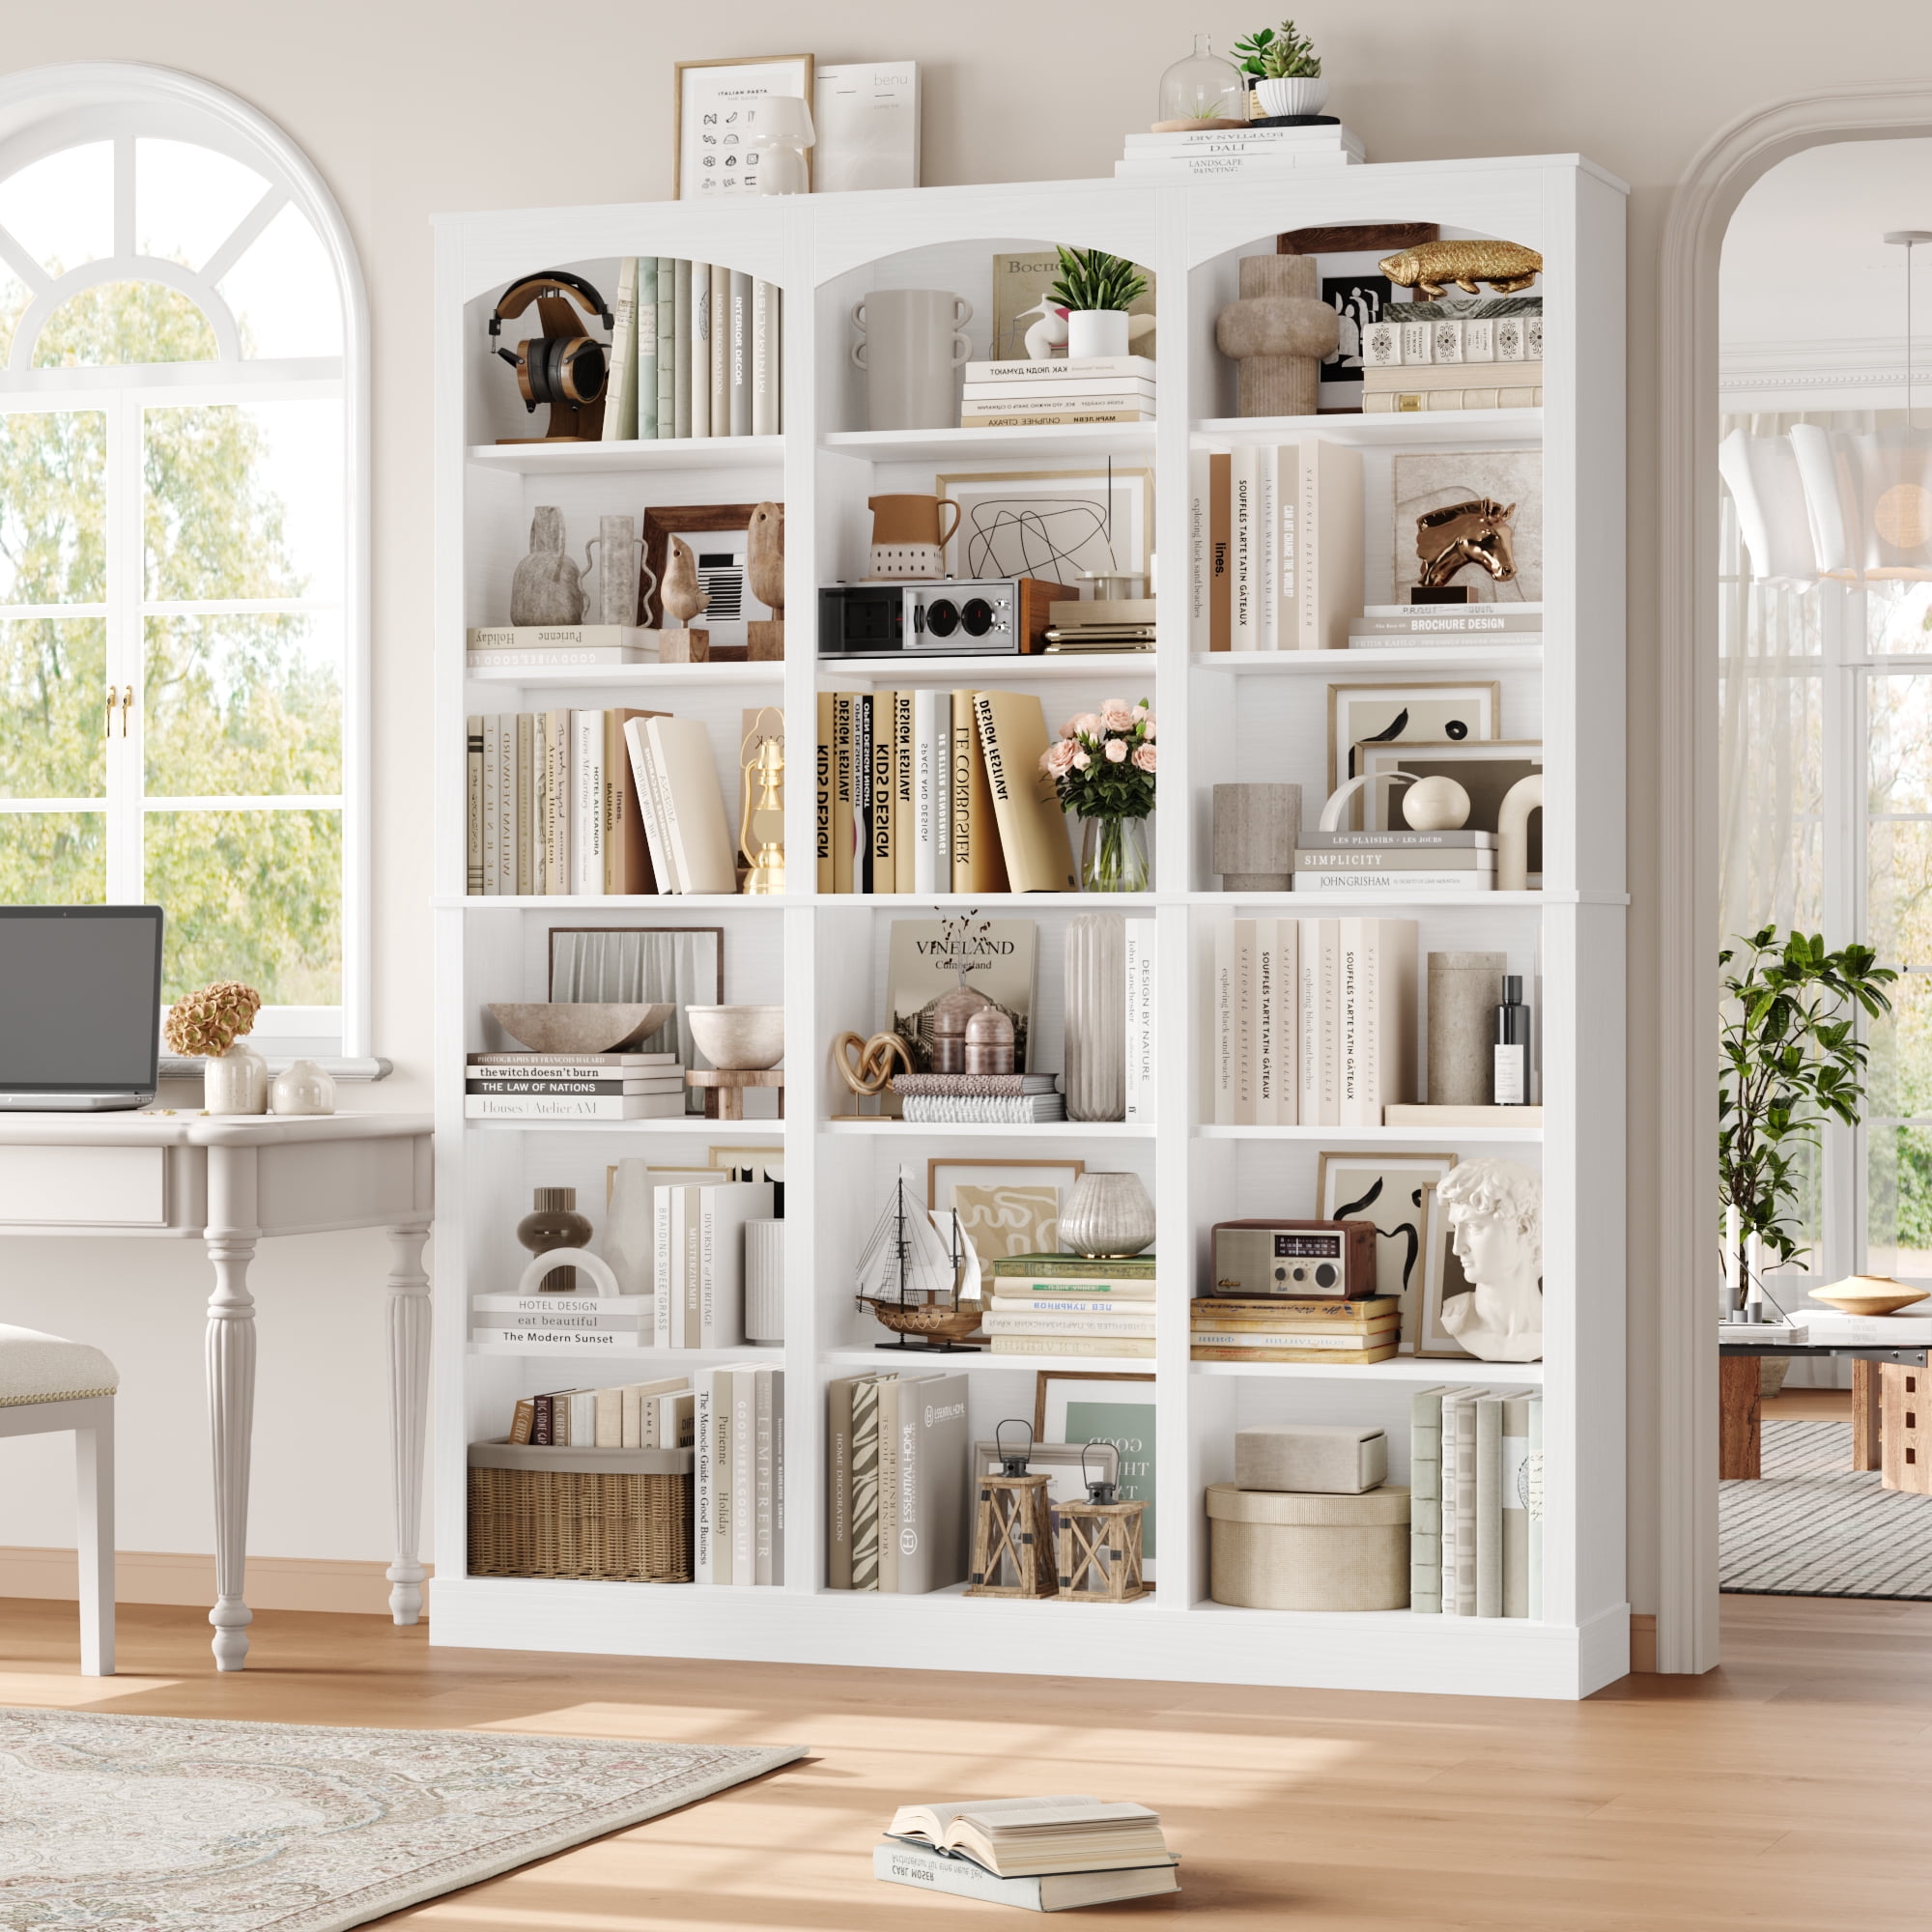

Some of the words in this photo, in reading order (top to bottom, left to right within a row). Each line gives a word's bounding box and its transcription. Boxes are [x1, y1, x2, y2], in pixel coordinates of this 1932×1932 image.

[874, 72, 908, 85] benu
[1189, 158, 1242, 168] LANDSCAPE
[1192, 497, 1203, 538] exploring
[1194, 540, 1203, 562] black
[1215, 542, 1226, 577] lines.
[1194, 564, 1203, 583] sand
[1194, 585, 1203, 618] beaches
[1411, 619, 1465, 631] BROCHURE
[1468, 618, 1505, 629] DESIGN
[476, 631, 514, 645] Holiday
[538, 632, 582, 642] Purienne
[1305, 855, 1382, 866] SIMPLICITY
[917, 941, 1014, 954] VINELAND
[1127, 939, 1136, 964] John
[1220, 968, 1230, 1008] exploring
[1304, 968, 1314, 1008] exploring
[1142, 1011, 1150, 1027] BY
[573, 1068, 599, 1077] burn
[482, 1083, 502, 1092] THE
[507, 1083, 528, 1092] LAW
[532, 1083, 546, 1092] OF
[550, 1083, 596, 1093] NATIONS
[483, 1100, 523, 1113] Houses
[534, 1101, 571, 1113] Atelier
[575, 1101, 596, 1113] AM
[658, 1208, 668, 1258] BRAIDING
[519, 1300, 554, 1310] HOTEL
[557, 1301, 597, 1311] DESIGN
[658, 1263, 668, 1330] SWEETGRASS
[542, 1316, 597, 1326] beautiful
[503, 1332, 524, 1341] The
[527, 1332, 571, 1343] Modern
[575, 1333, 613, 1344] Sunset
[537, 1400, 547, 1411] BIG
[555, 1402, 564, 1411] BIG
[699, 1391, 709, 1409] The
[537, 1413, 548, 1431] STONE
[555, 1414, 564, 1437] CHERRY
[737, 1401, 747, 1439] GOOD
[537, 1433, 548, 1444] GAP
[699, 1413, 709, 1452] Monocle
[719, 1416, 728, 1465] Purienne
[903, 1423, 912, 1462] HOME
[699, 1455, 709, 1483] Guide
[699, 1486, 709, 1494] to
[903, 1464, 912, 1522] ESSENTIAL
[699, 1497, 709, 1522] Good
[716, 1492, 728, 1536] Holiday
[737, 1488, 747, 1527] GOOD
[699, 1526, 709, 1565] Business
[737, 1532, 747, 1562] LIFE
